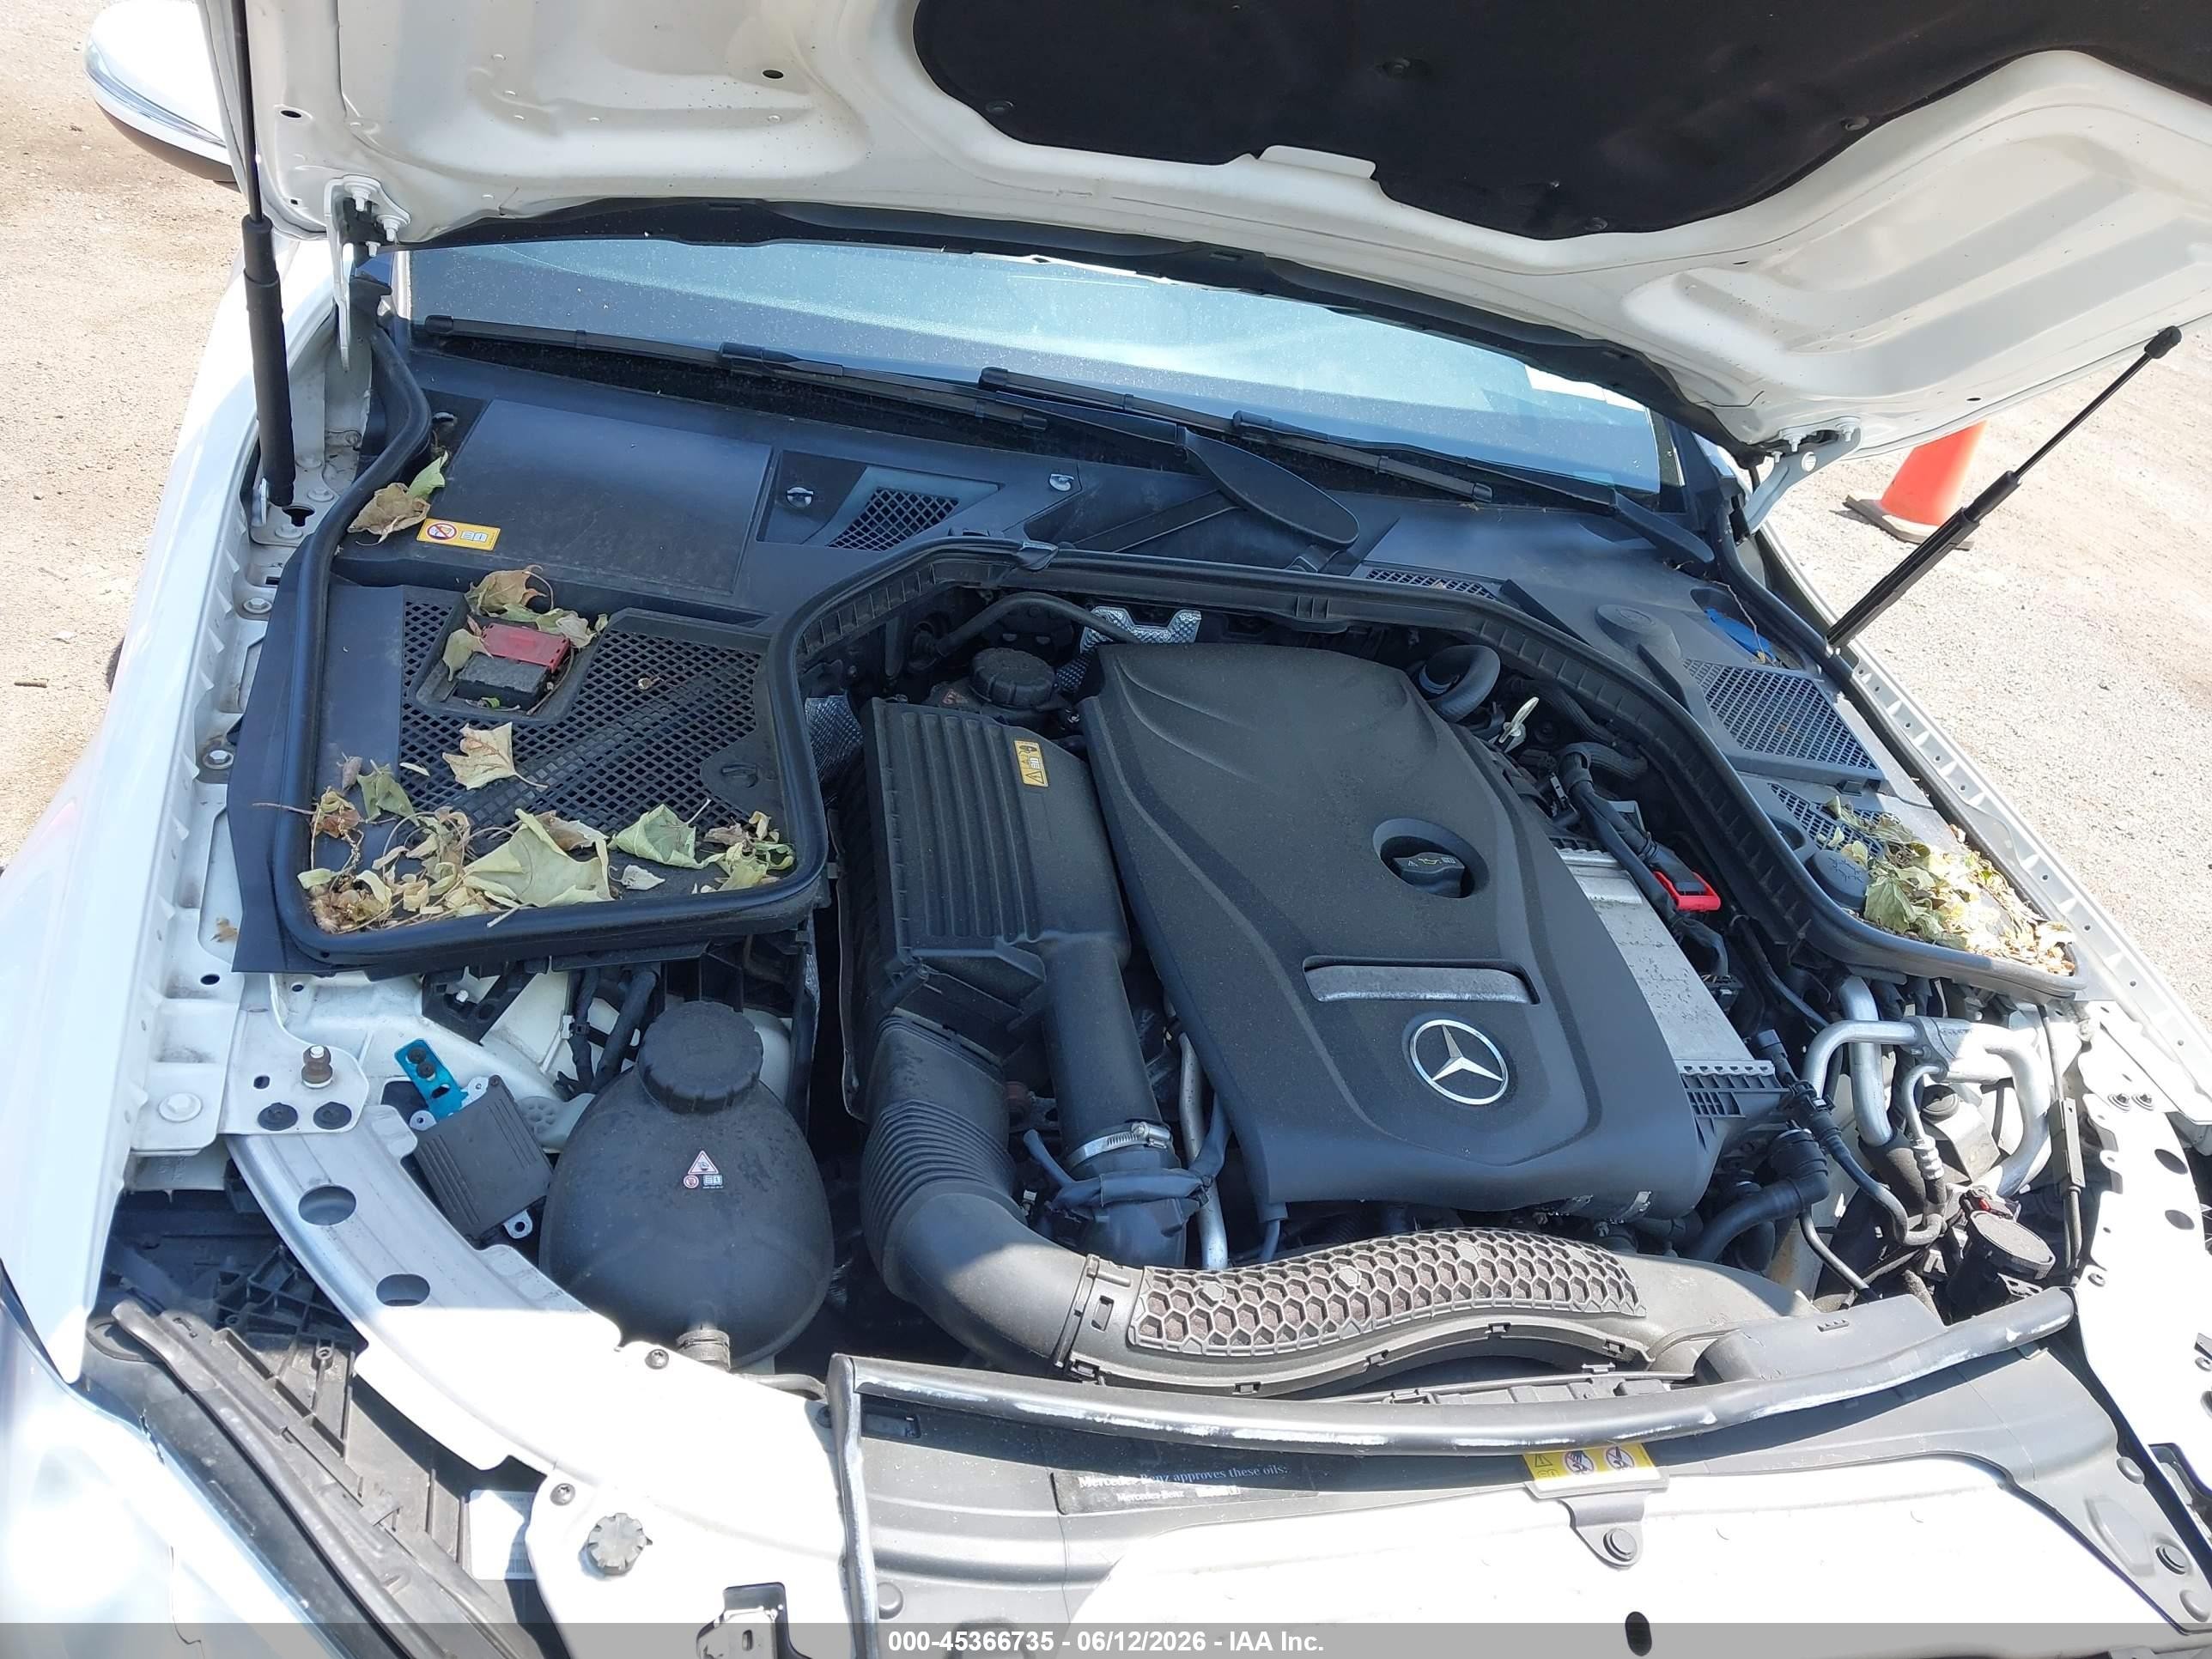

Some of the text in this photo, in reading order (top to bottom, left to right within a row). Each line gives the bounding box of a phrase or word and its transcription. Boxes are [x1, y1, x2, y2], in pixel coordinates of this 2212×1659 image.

[1173, 1469, 1227, 1483] approves
[1229, 1467, 1261, 1478] these
[1262, 1464, 1288, 1475] oils:
[1116, 1490, 1184, 1502] Mercedes-Benz
